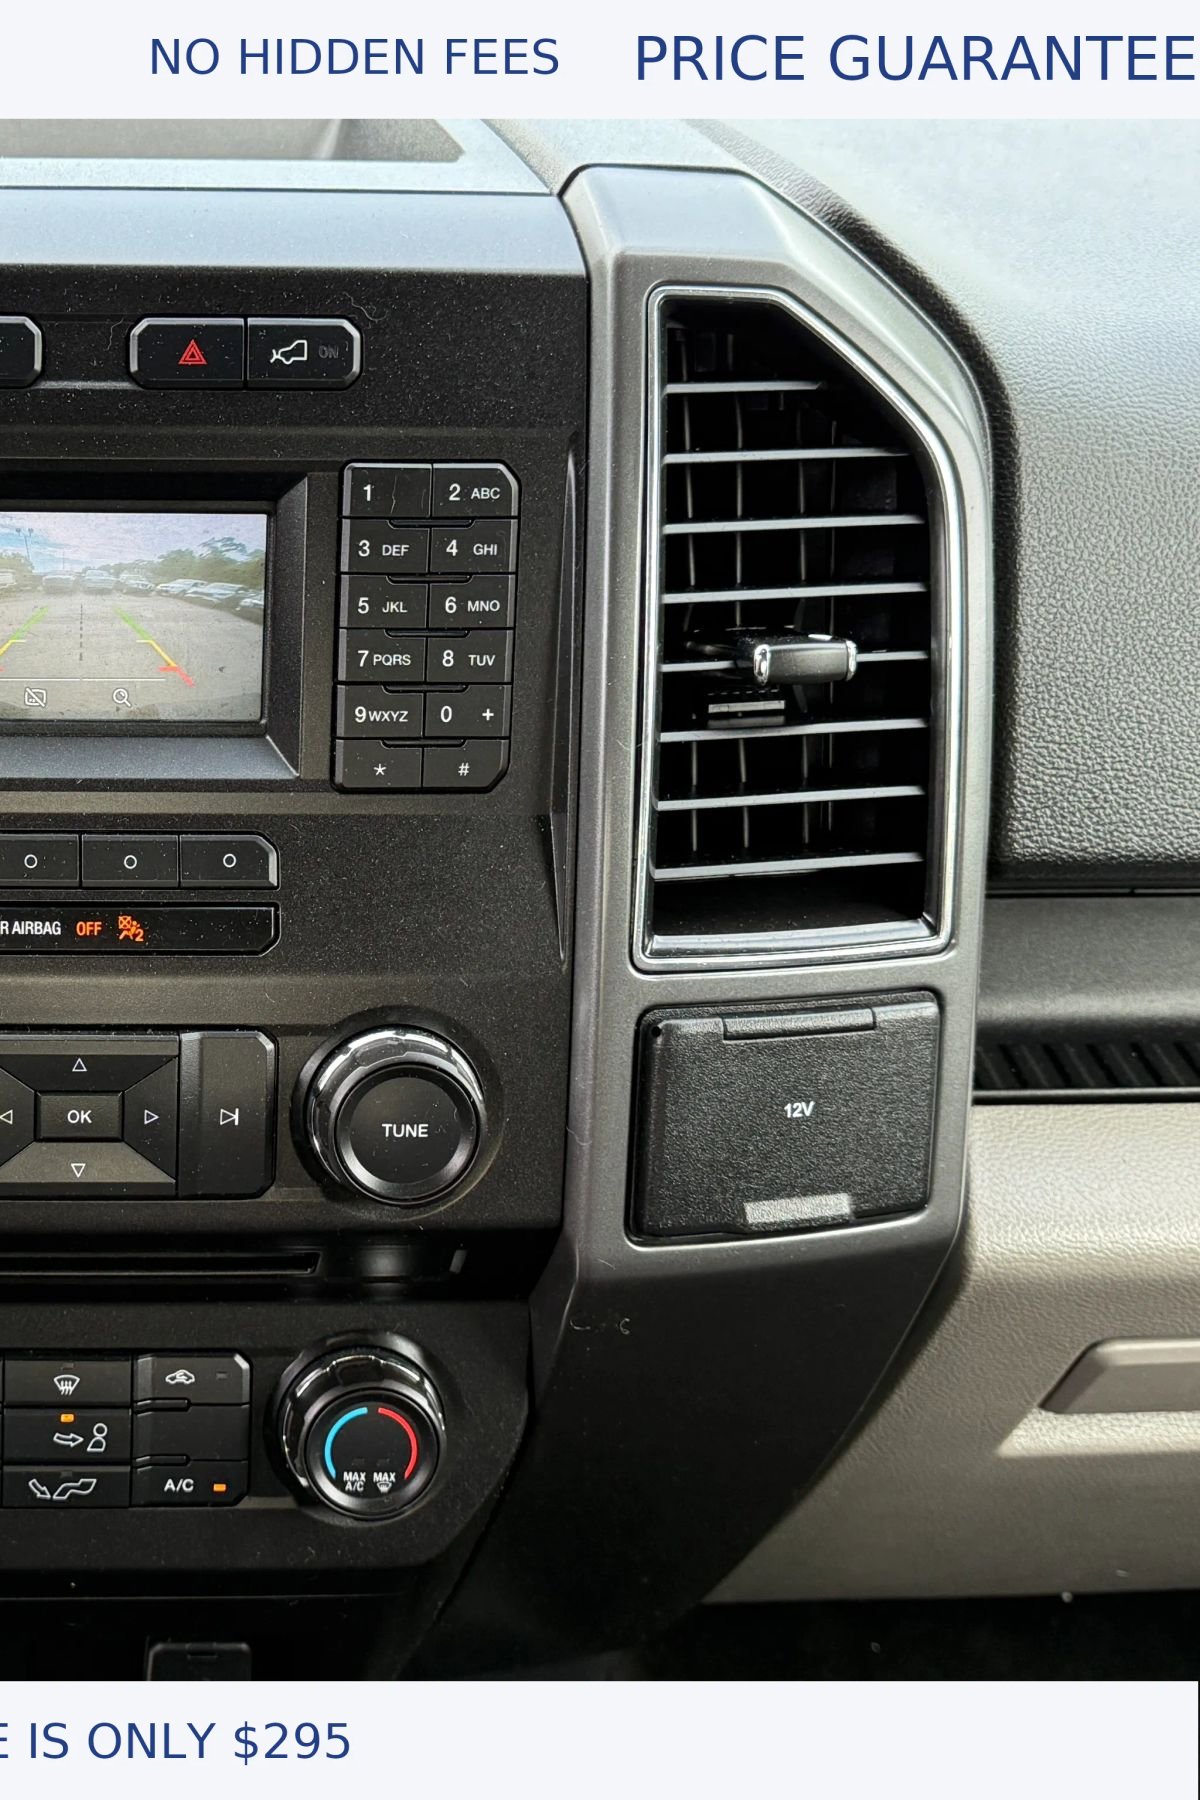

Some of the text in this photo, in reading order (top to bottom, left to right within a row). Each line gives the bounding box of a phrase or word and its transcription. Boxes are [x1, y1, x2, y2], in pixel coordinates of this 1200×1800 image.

[362, 484, 372, 502] 1
[448, 483, 501, 501] 2 ABC
[358, 539, 410, 557] 3 DEF
[445, 539, 498, 557] 4 GHI
[357, 596, 408, 614] 5 JKL
[444, 596, 501, 614] 6 MNO
[357, 649, 412, 668] 7 PQRS
[442, 649, 496, 667] 8 TUV
[354, 706, 409, 723] 9 WXYZ
[440, 705, 453, 723] 0
[11, 920, 62, 936] AIRBAG
[76, 921, 102, 936] OFF
[67, 1109, 92, 1124] OK
[783, 1100, 816, 1119] 12V
[381, 1123, 429, 1139] TUNE
[163, 1478, 195, 1492] A/C
[343, 1471, 367, 1482] MAX
[373, 1471, 396, 1482] MAX
[344, 1482, 365, 1492] A/C
